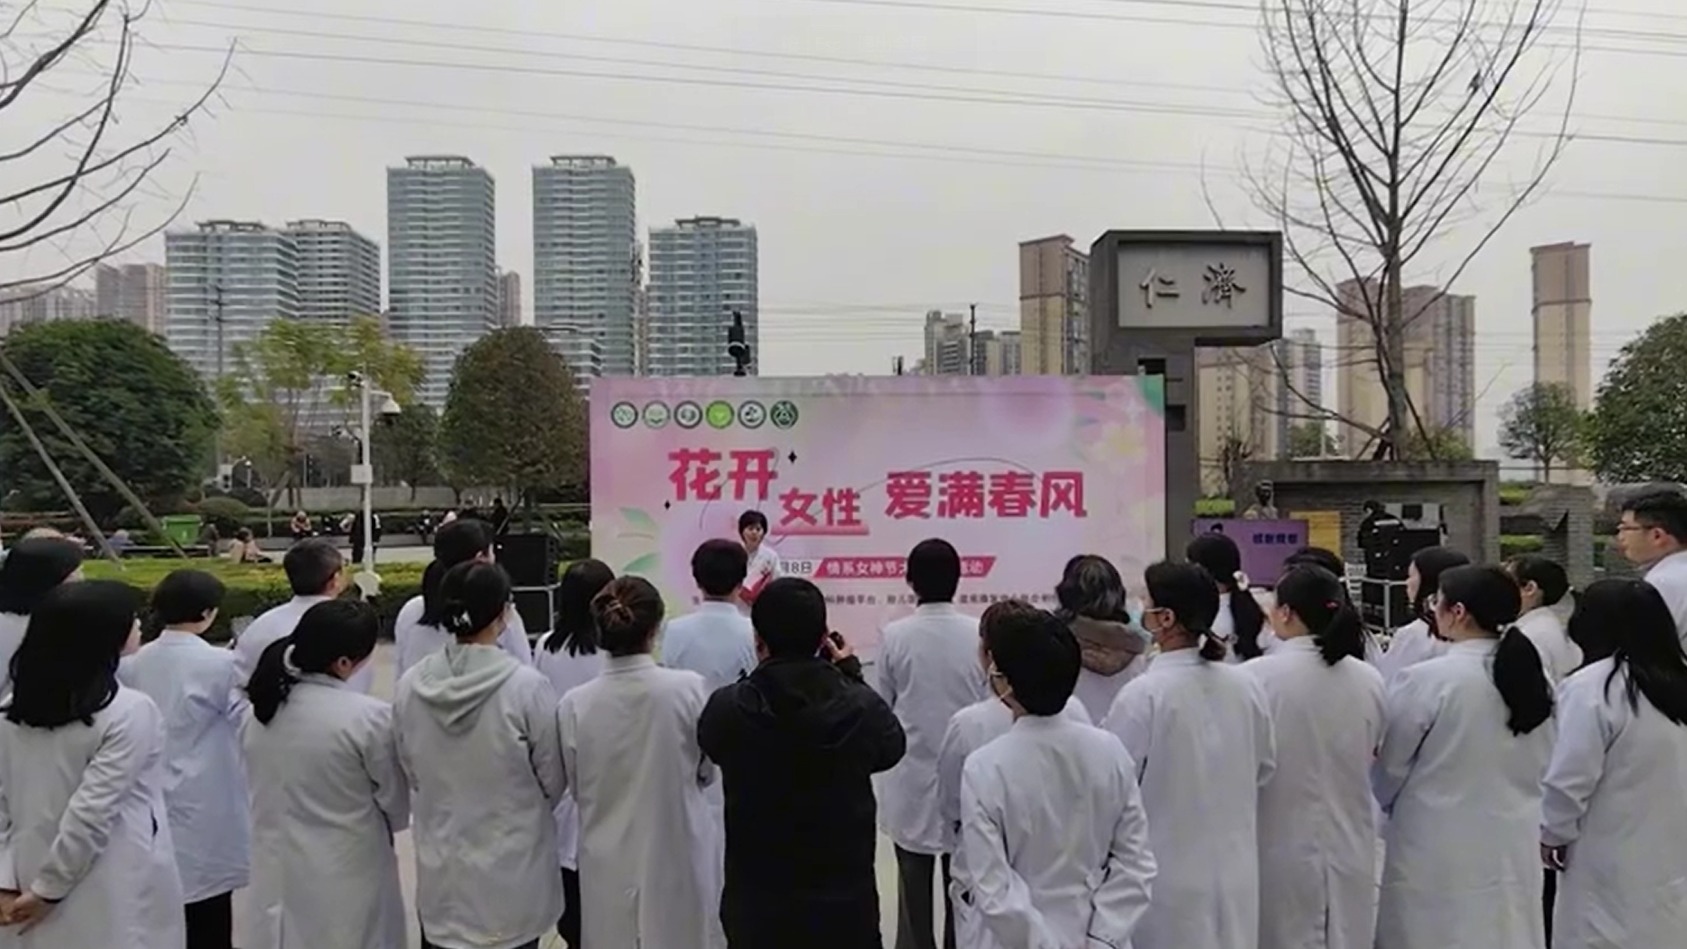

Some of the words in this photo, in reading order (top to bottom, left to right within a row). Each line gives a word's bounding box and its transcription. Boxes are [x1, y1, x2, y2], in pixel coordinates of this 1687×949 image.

[668, 448, 778, 501] 花开
[779, 487, 861, 526] 女性
[885, 470, 1087, 519] 爱满春风
